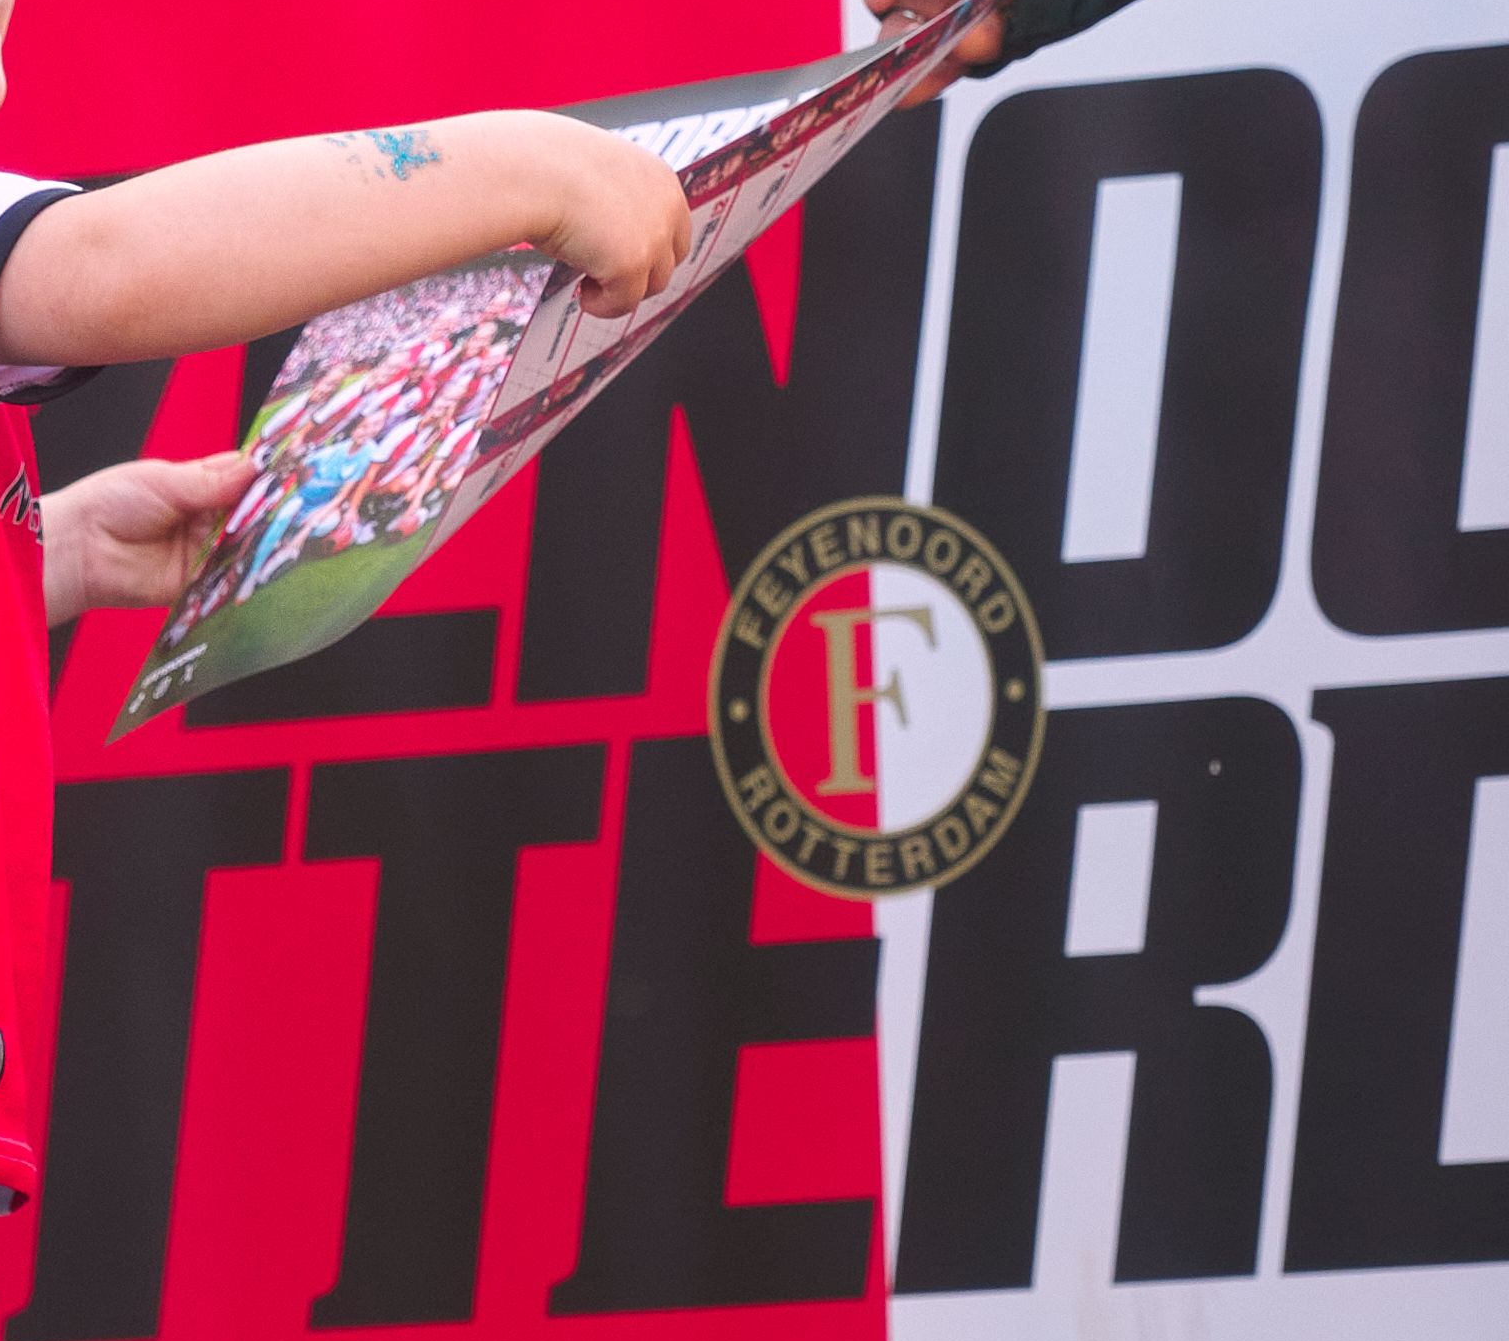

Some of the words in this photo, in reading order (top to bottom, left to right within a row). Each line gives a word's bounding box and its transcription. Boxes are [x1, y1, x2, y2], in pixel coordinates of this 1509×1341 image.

[736, 513, 1017, 650] FEYENOORD
[809, 603, 939, 797] F
[737, 745, 1022, 885] ROTTERDAM
